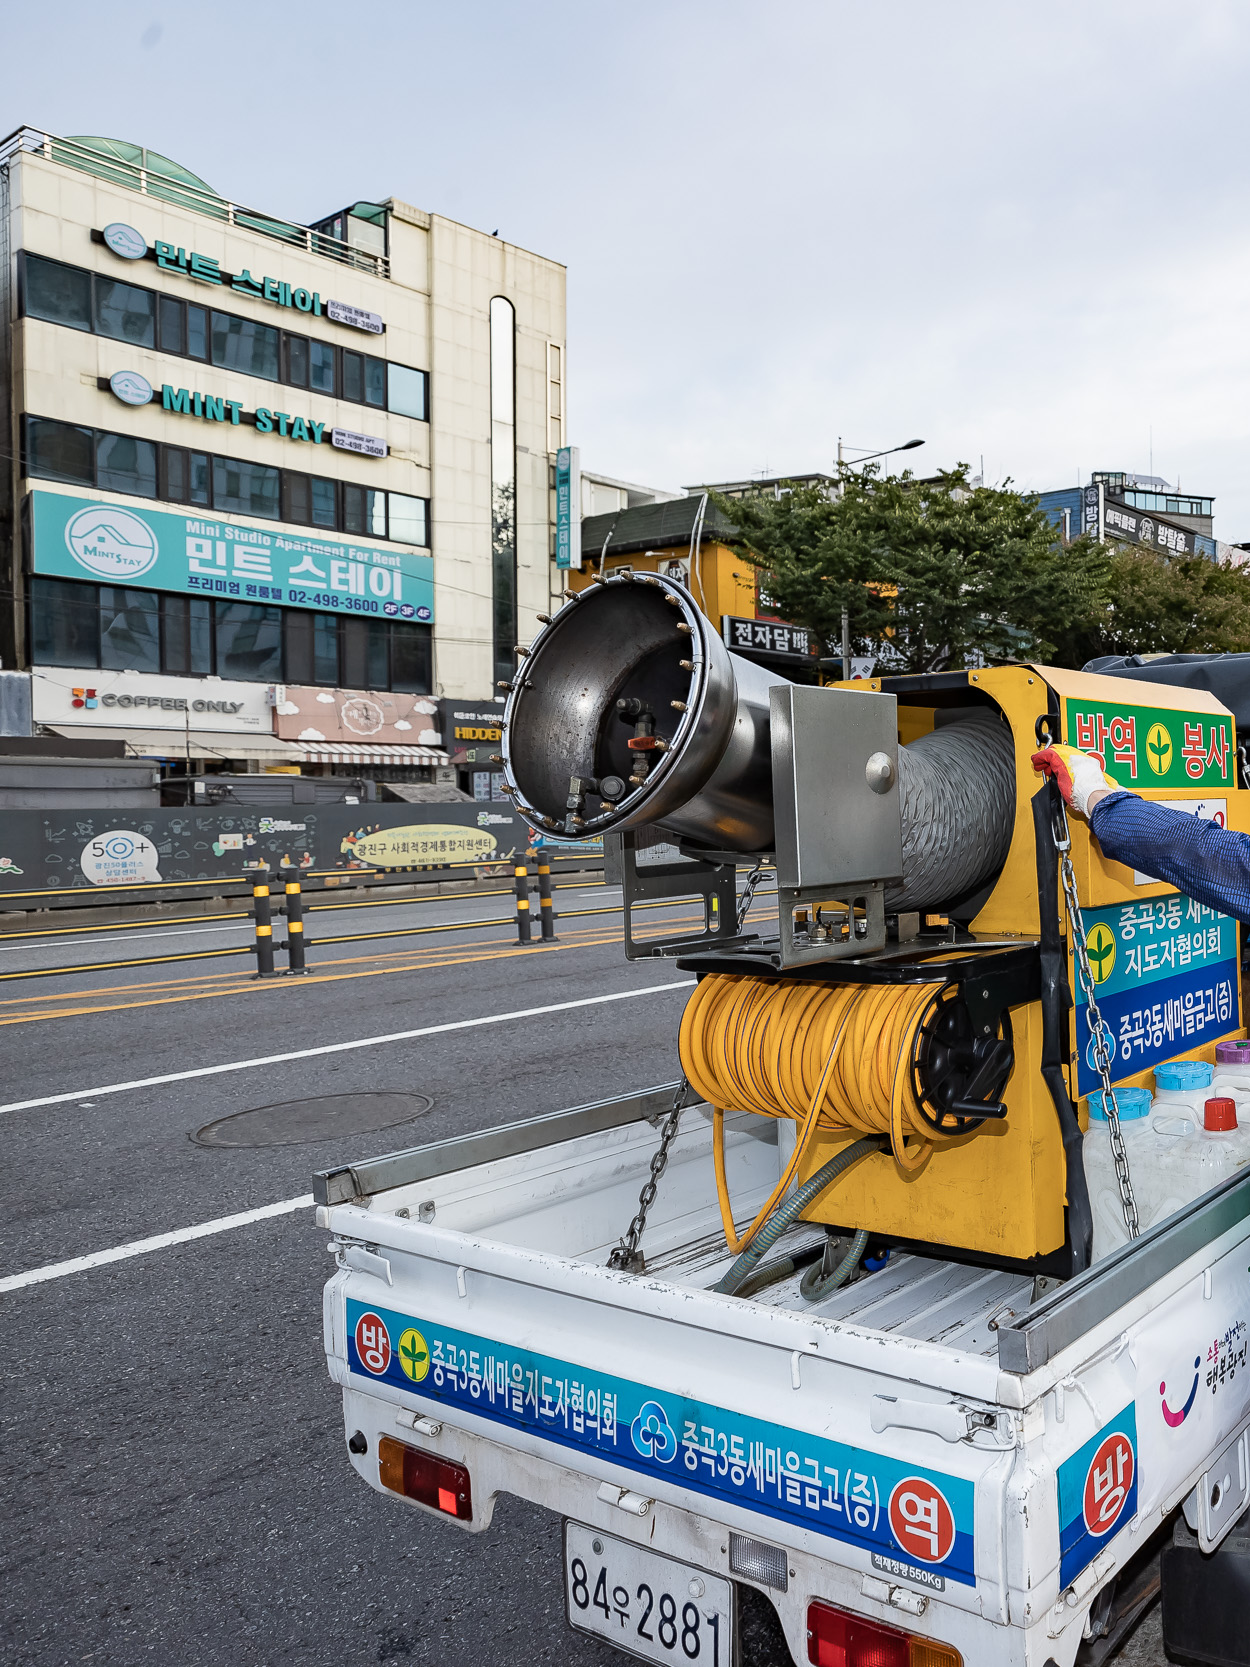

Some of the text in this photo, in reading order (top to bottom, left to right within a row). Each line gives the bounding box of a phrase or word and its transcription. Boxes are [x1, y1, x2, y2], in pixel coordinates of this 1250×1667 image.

[155, 240, 321, 316] 민트 스테이
[162, 384, 326, 444] MINT STAY
[186, 519, 401, 567] Mini Studio Apartment For Rent
[186, 536, 402, 601] 민트 스테이
[187, 575, 431, 619] 프리미엄 원룸텔 02-498-3600 2F 3F 4F
[101, 693, 244, 714] COFFEE ONLY
[1076, 713, 1230, 779] 방역 봉사
[357, 838, 491, 856] 광진구 사회적경제통합지원센터
[1118, 898, 1183, 940] 중곡3동
[1124, 925, 1221, 978] 지도자협의회
[362, 1322, 387, 1369] 방
[431, 1339, 618, 1446] 중곡3동새마을지도자협의회
[1093, 1443, 1130, 1523] 방
[898, 1490, 939, 1557] 역
[874, 1554, 942, 1589] 적재정량 550Kg
[571, 1557, 721, 1667] 84우2881
